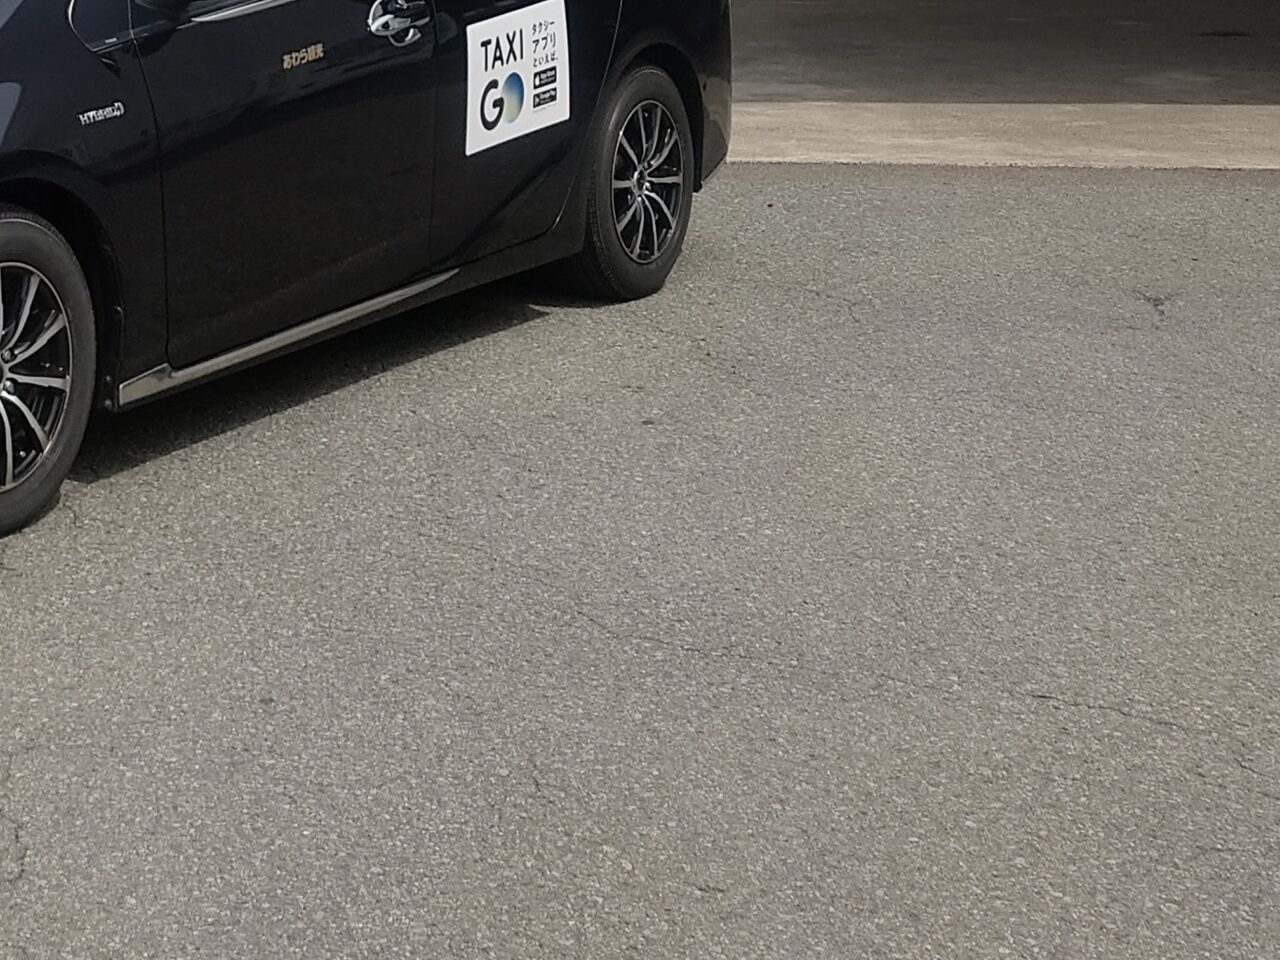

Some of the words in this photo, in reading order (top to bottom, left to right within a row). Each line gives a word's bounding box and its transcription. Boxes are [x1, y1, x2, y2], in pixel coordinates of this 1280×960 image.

[532, 20, 555, 36] タクシー
[532, 31, 556, 54] アプリ
[480, 28, 524, 72] TAXI
[480, 72, 525, 131] GO
